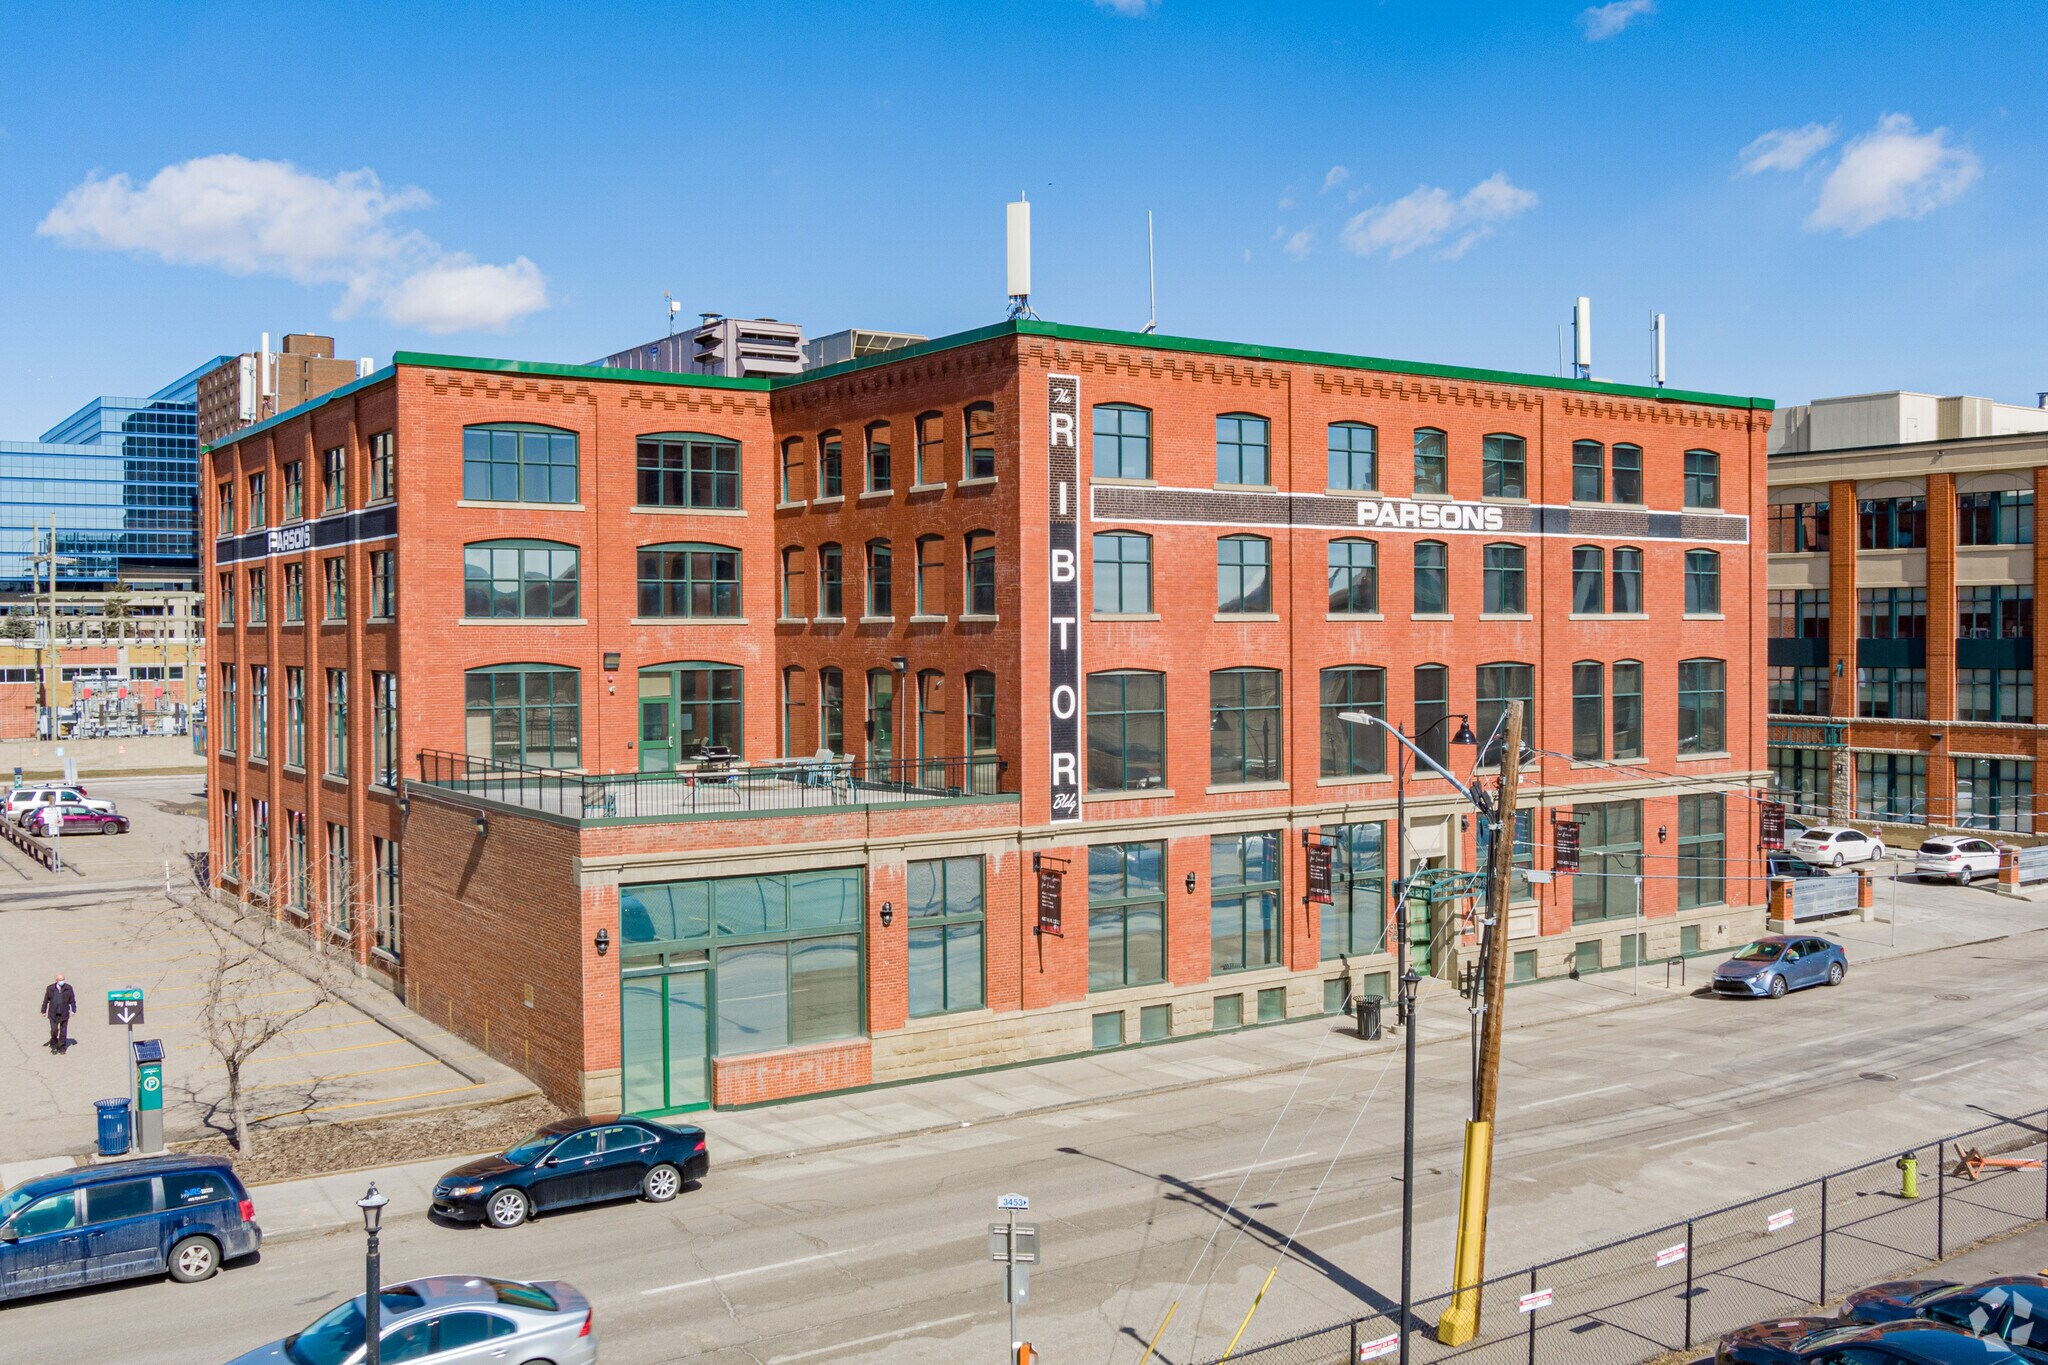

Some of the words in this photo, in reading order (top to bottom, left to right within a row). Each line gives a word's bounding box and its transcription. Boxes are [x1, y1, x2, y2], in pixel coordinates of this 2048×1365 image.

[1053, 388, 1072, 404] The
[1357, 501, 1503, 531] PARSONS
[268, 525, 310, 553] PARSONS
[1051, 412, 1077, 787] RIBTOR
[1053, 793, 1077, 814] Bldg
[1003, 1198, 1023, 1206] 3453
